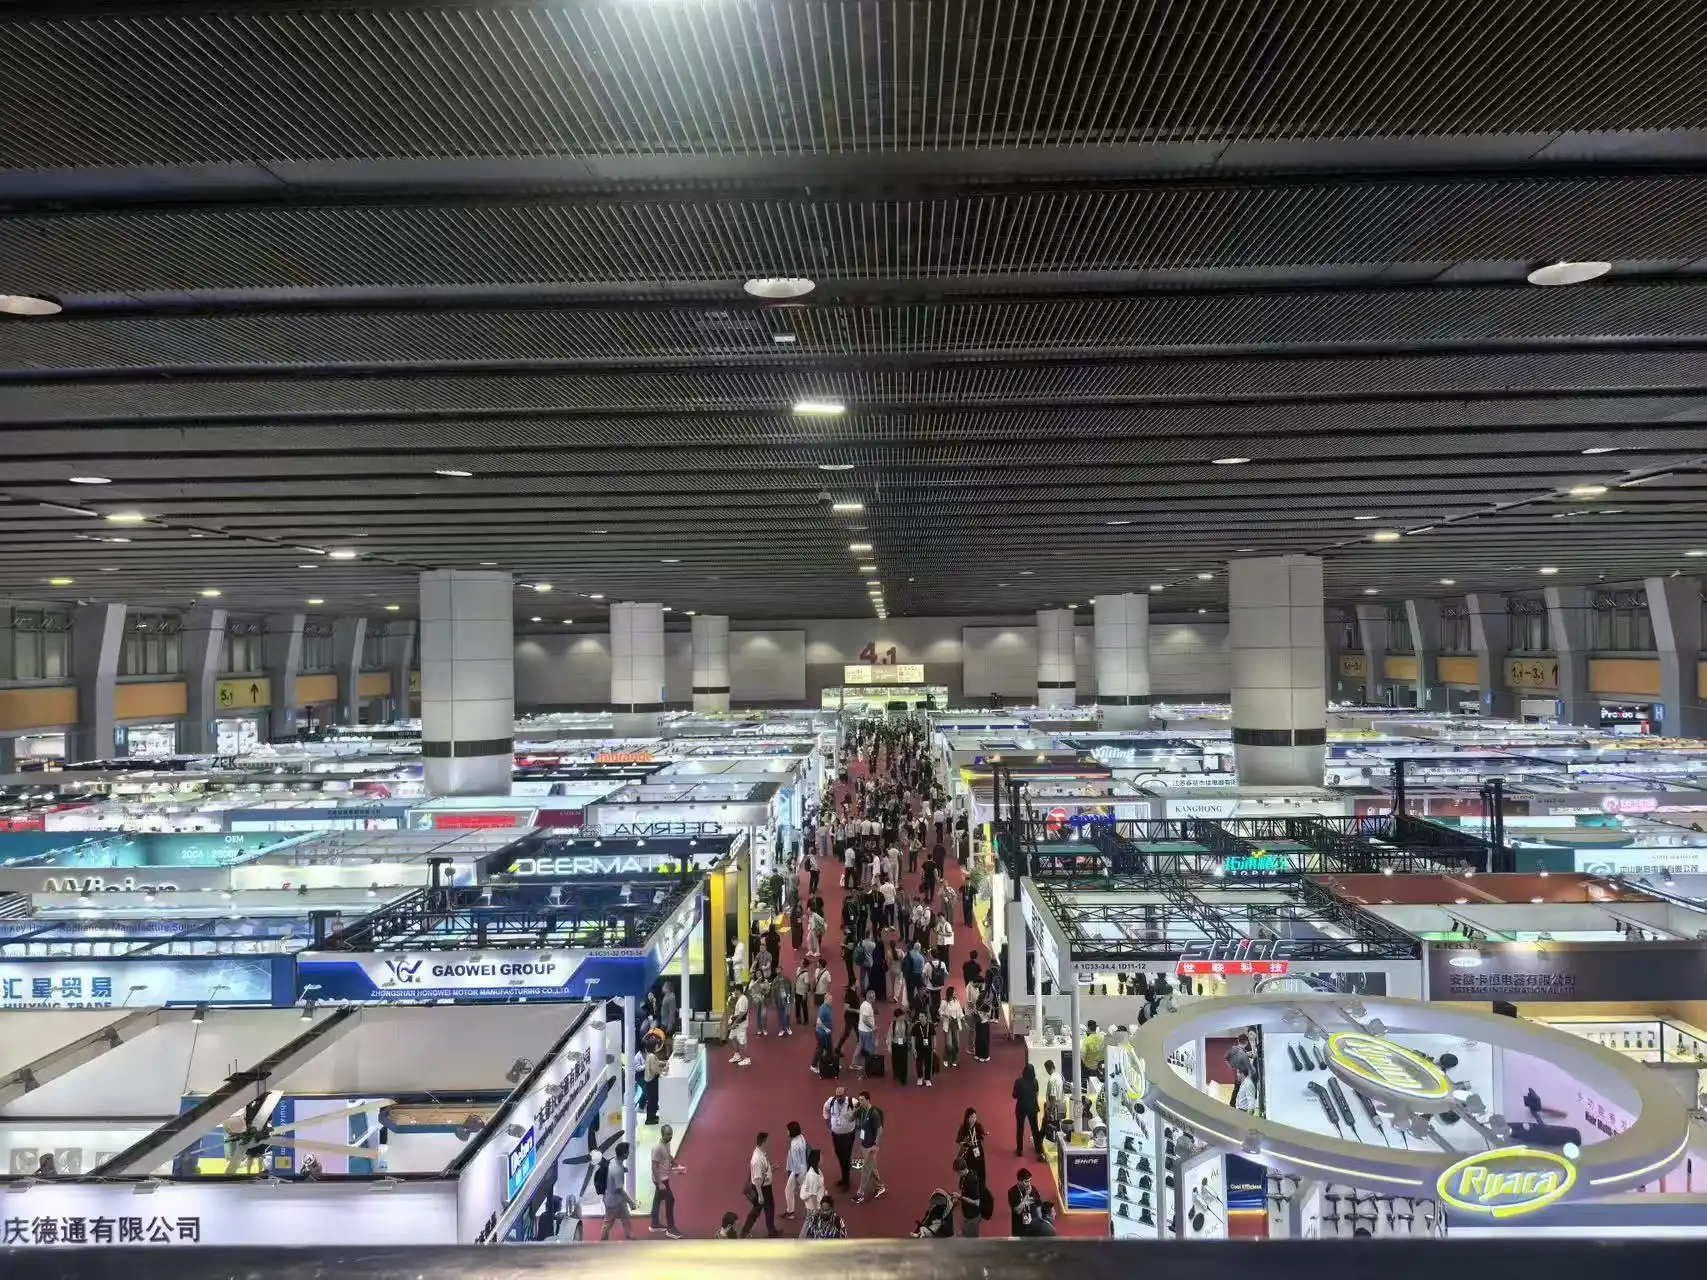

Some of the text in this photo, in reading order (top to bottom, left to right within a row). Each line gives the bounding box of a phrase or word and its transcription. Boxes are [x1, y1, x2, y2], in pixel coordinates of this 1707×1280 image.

[859, 642, 897, 665] 4.1
[1655, 706, 1663, 720] H
[115, 727, 124, 745] H
[1175, 805, 1223, 813] KANGHONG
[225, 835, 244, 843] OEM
[514, 857, 643, 875] DEERMA
[432, 963, 556, 977] GAOWEI GROUP
[1183, 963, 1283, 973] 世联科技
[3, 977, 112, 999] 汇星贸易
[417, 989, 452, 997] HONGWEI
[453, 988, 478, 996] MOTOR
[3, 1216, 201, 1244] 庆德通有限公司
